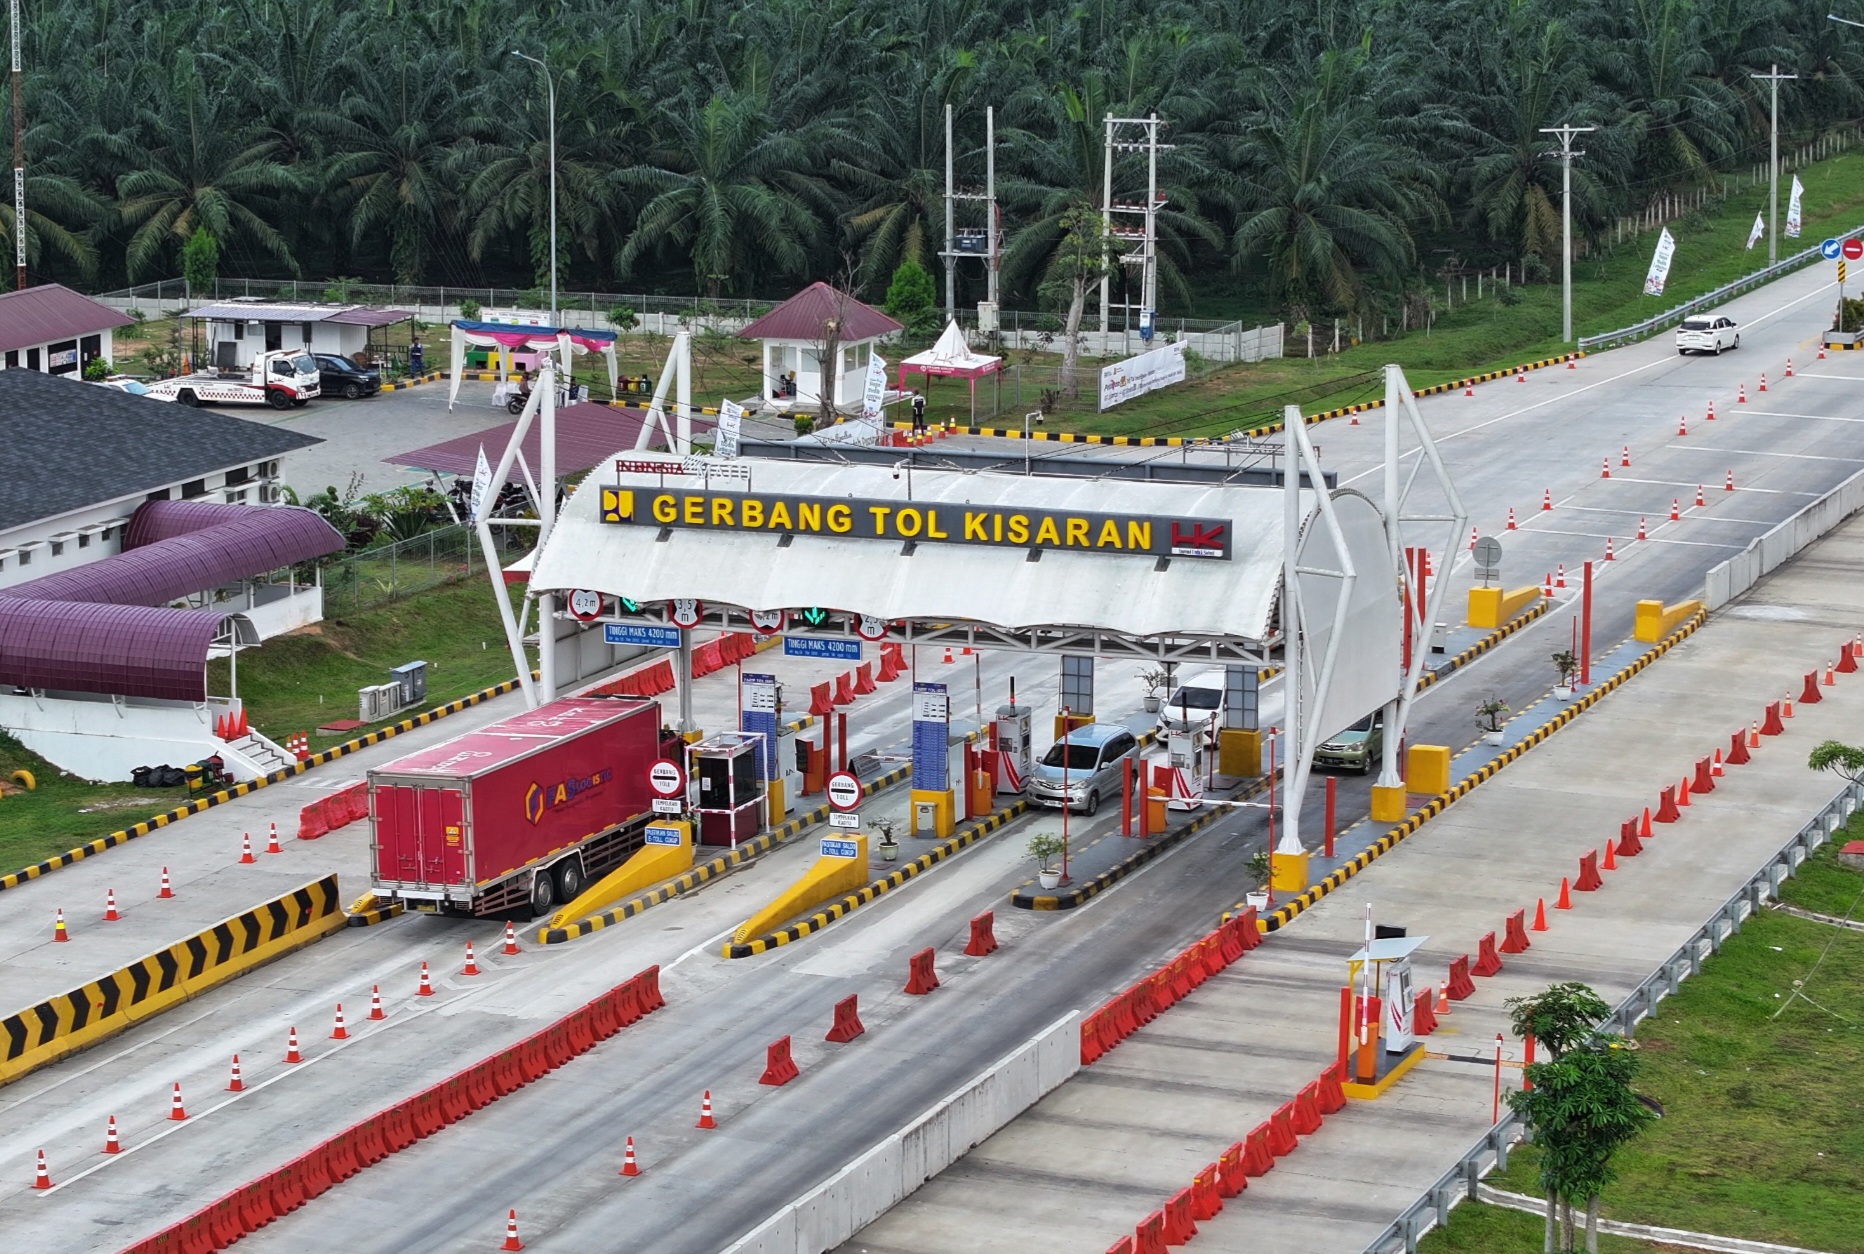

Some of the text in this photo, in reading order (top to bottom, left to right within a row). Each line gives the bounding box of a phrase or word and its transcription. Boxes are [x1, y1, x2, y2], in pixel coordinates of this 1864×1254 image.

[653, 494, 1151, 549] GERBANG TOL KISARAN
[1172, 521, 1224, 549] HK
[678, 599, 692, 612] 3,5
[681, 613, 689, 622] m
[609, 626, 677, 639] TINGGI MAKS 4200 mm
[867, 626, 875, 635] m
[788, 639, 858, 653] TINGGI MAKS 4200 mm
[831, 781, 855, 789] GERBANG
